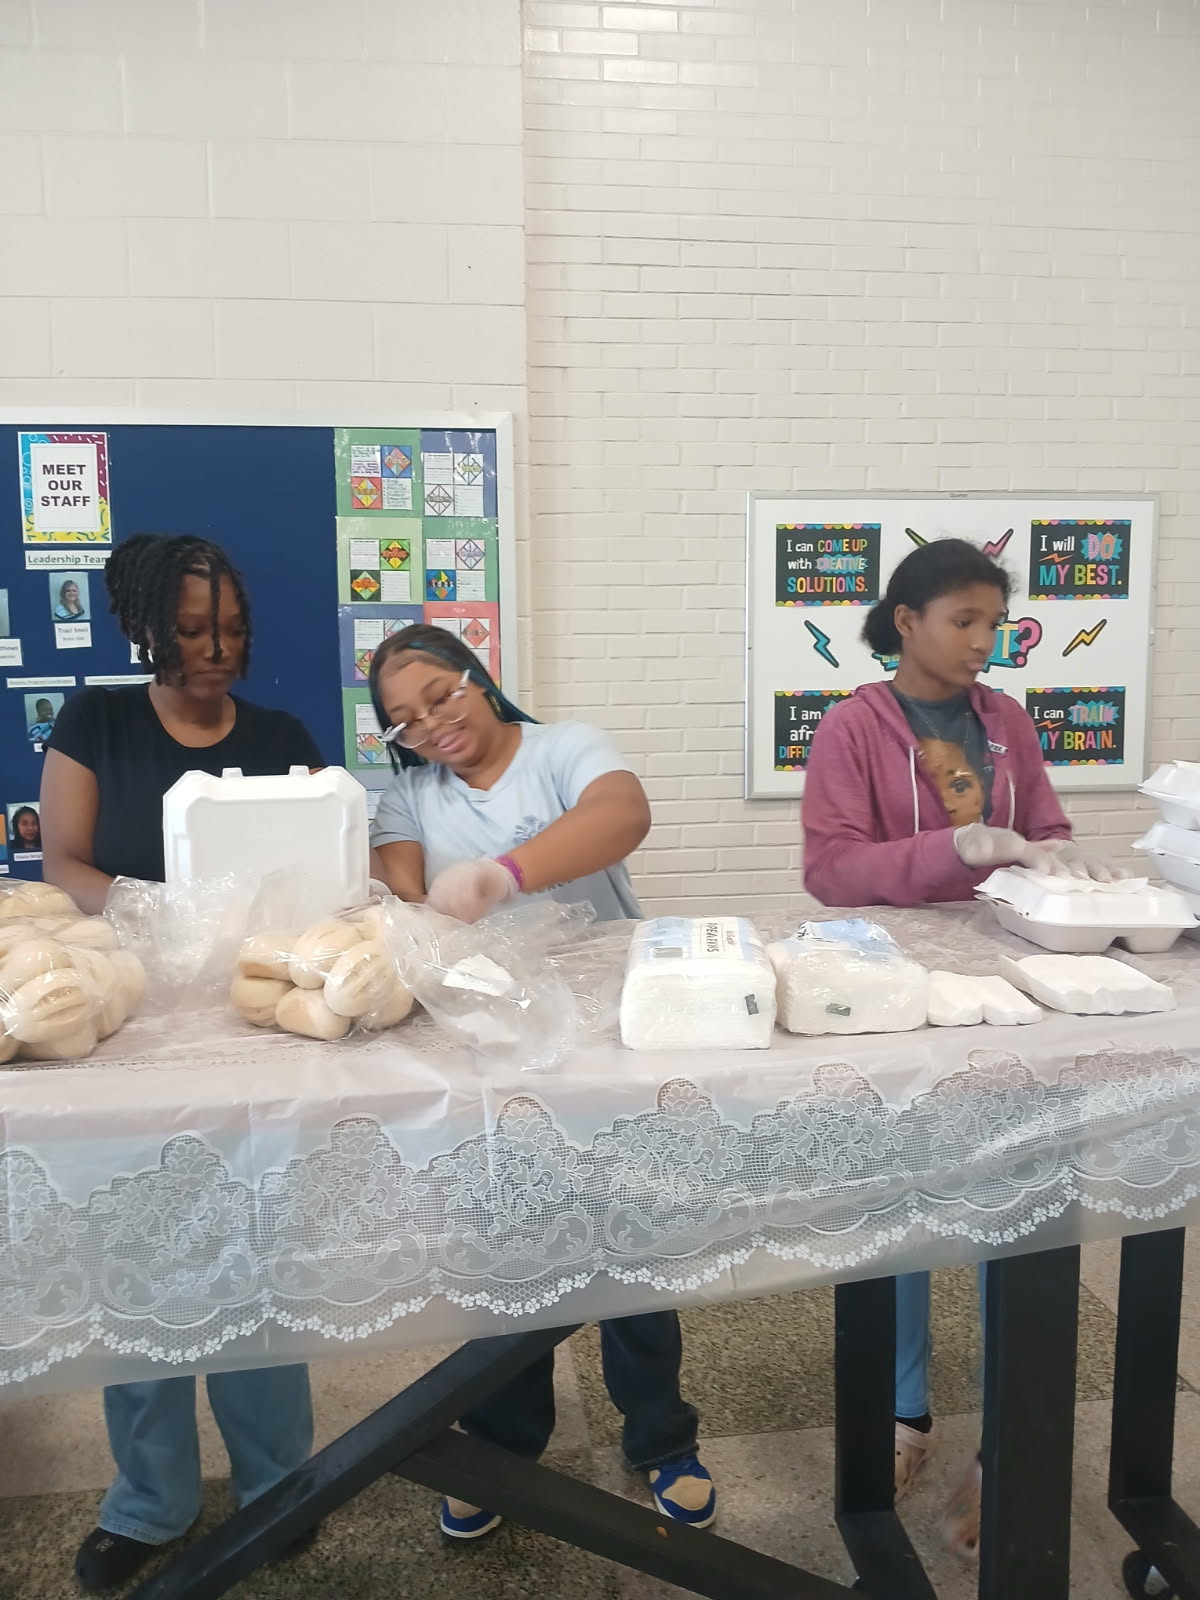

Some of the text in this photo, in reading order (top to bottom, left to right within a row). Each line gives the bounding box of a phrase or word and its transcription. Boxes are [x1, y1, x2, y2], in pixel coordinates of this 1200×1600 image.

[42, 464, 86, 475] MEET
[47, 480, 82, 491] OUR
[41, 496, 91, 507] STAFF
[786, 539, 868, 552] I can COME UP
[1040, 533, 1116, 560] I will DO
[28, 554, 81, 565] Leadership
[787, 557, 865, 570] with CREATIVE
[1040, 564, 1122, 585] MY BEST.
[786, 576, 868, 593] SOLUTIONS.
[789, 706, 822, 720] I am
[1033, 705, 1114, 725] I can TRAIN
[789, 725, 815, 741] afr
[1063, 730, 1116, 750] BRAIN.
